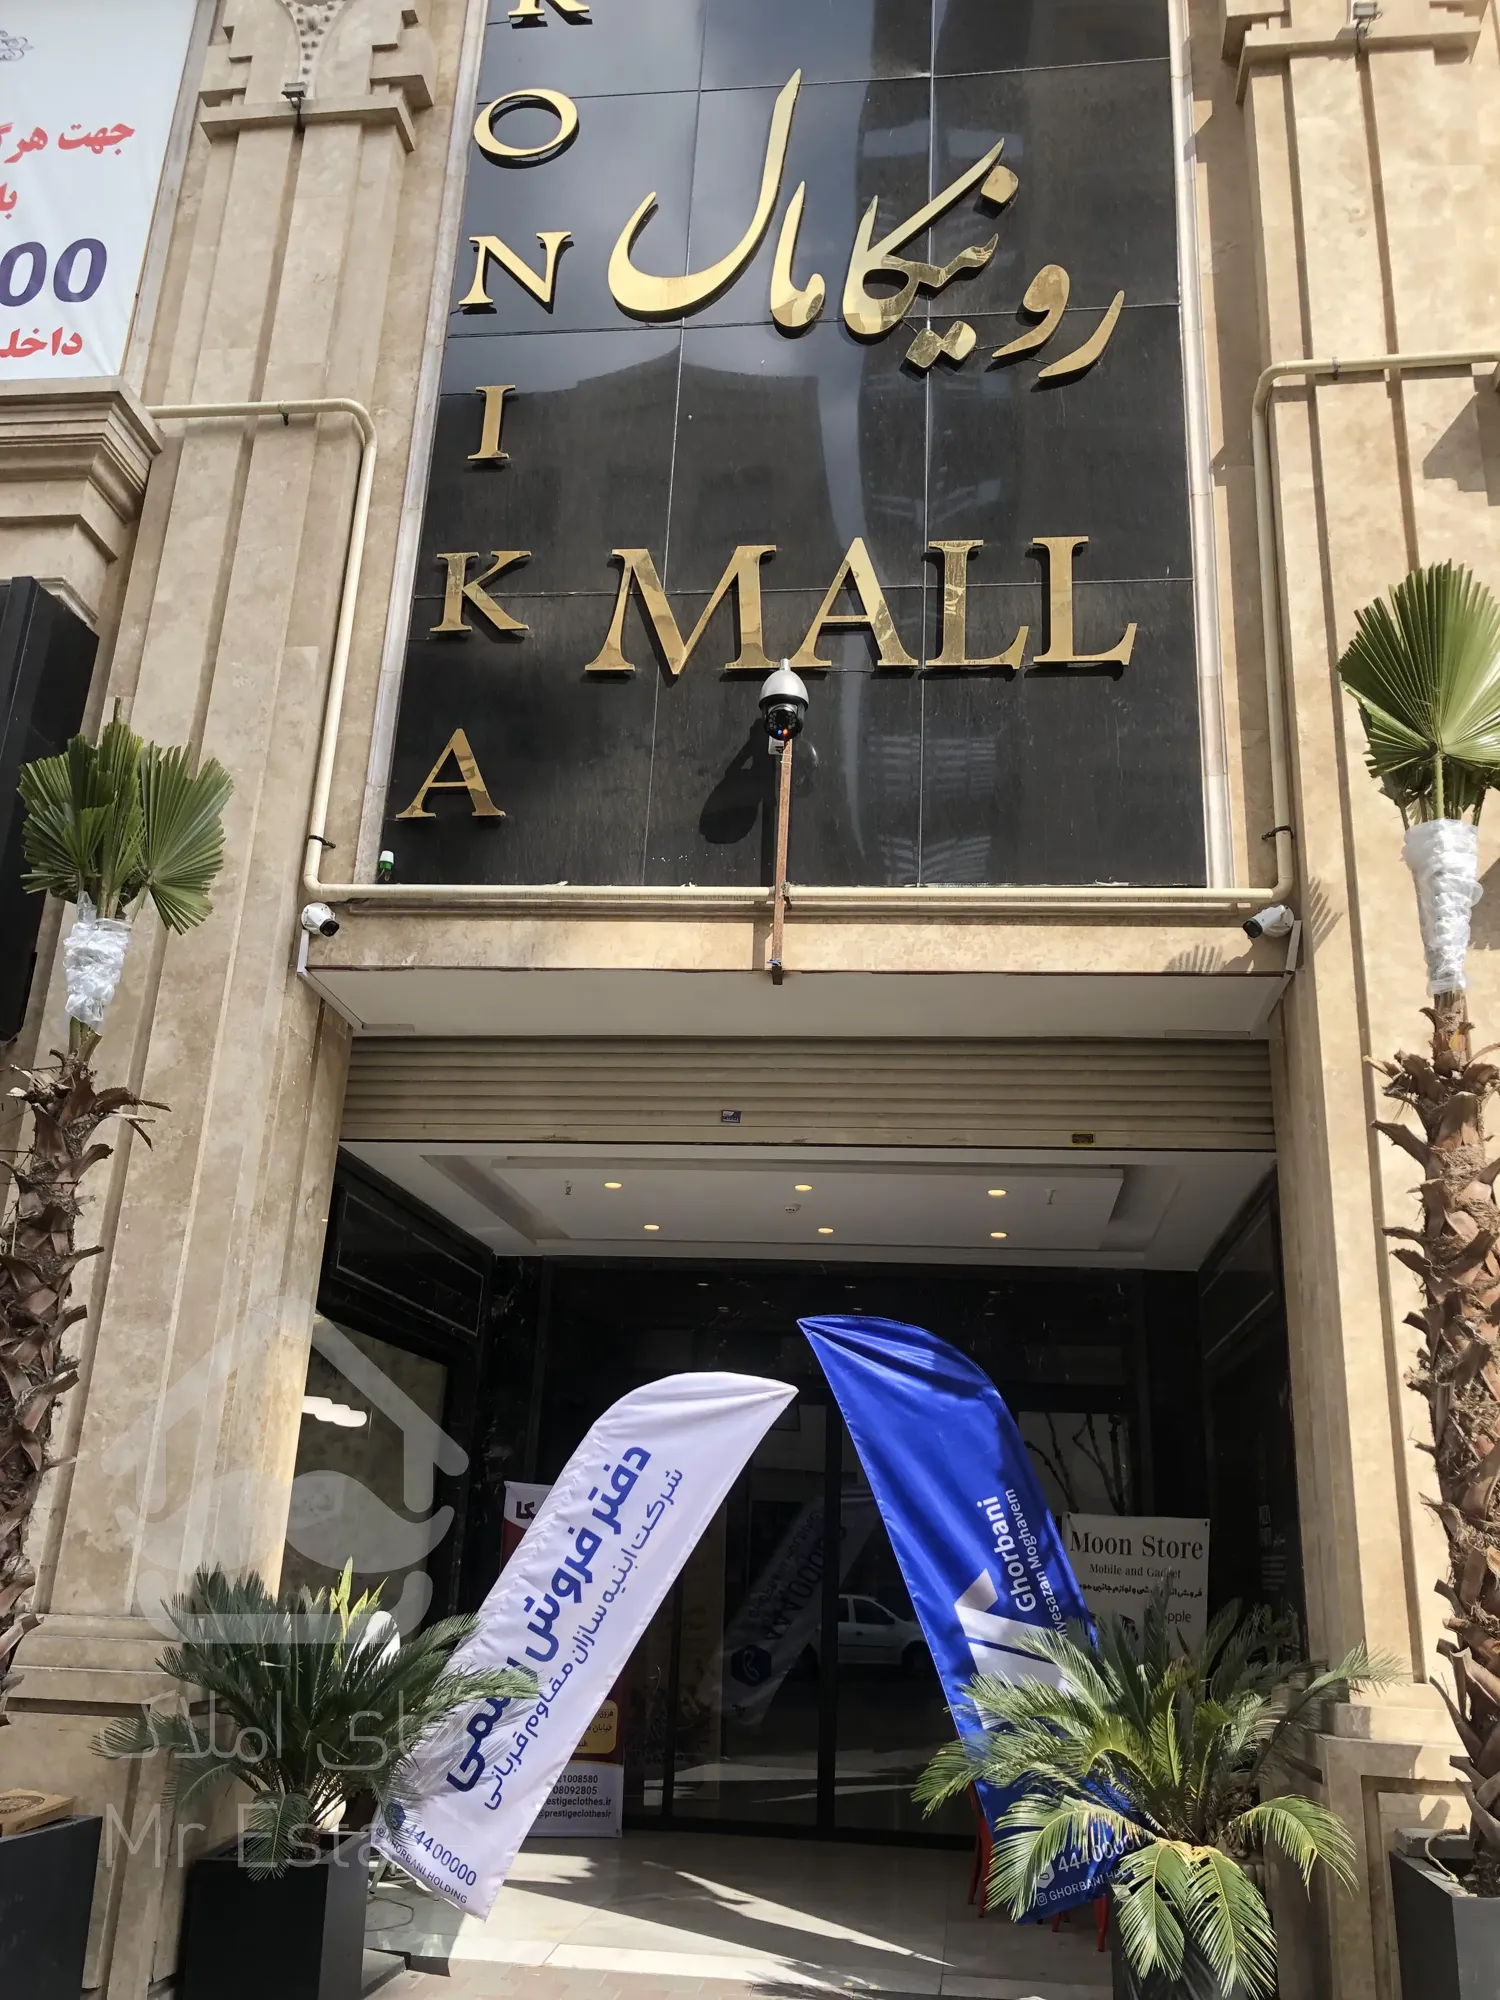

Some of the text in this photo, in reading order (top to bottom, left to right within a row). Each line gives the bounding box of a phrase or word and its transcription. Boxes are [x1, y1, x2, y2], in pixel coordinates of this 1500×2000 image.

[58, 122, 136, 156] جهت
[395, 0, 592, 820] ONIKA
[584, 535, 1139, 677] MALL
[587, 1445, 652, 1536] دفتر
[1005, 1488, 1042, 1570] Moghavem
[976, 1495, 1037, 1613] Ghorbani
[1069, 1530, 1204, 1560] Moon Store
[1089, 1562, 1182, 1580] Mobile and Gadet
[523, 1526, 604, 1663] فروش
[1165, 1609, 1193, 1625] pple
[483, 1468, 684, 1811] شرکت ابنیه سازان مقاوم قربانی
[545, 1796, 612, 1808] estigeclothes.ir
